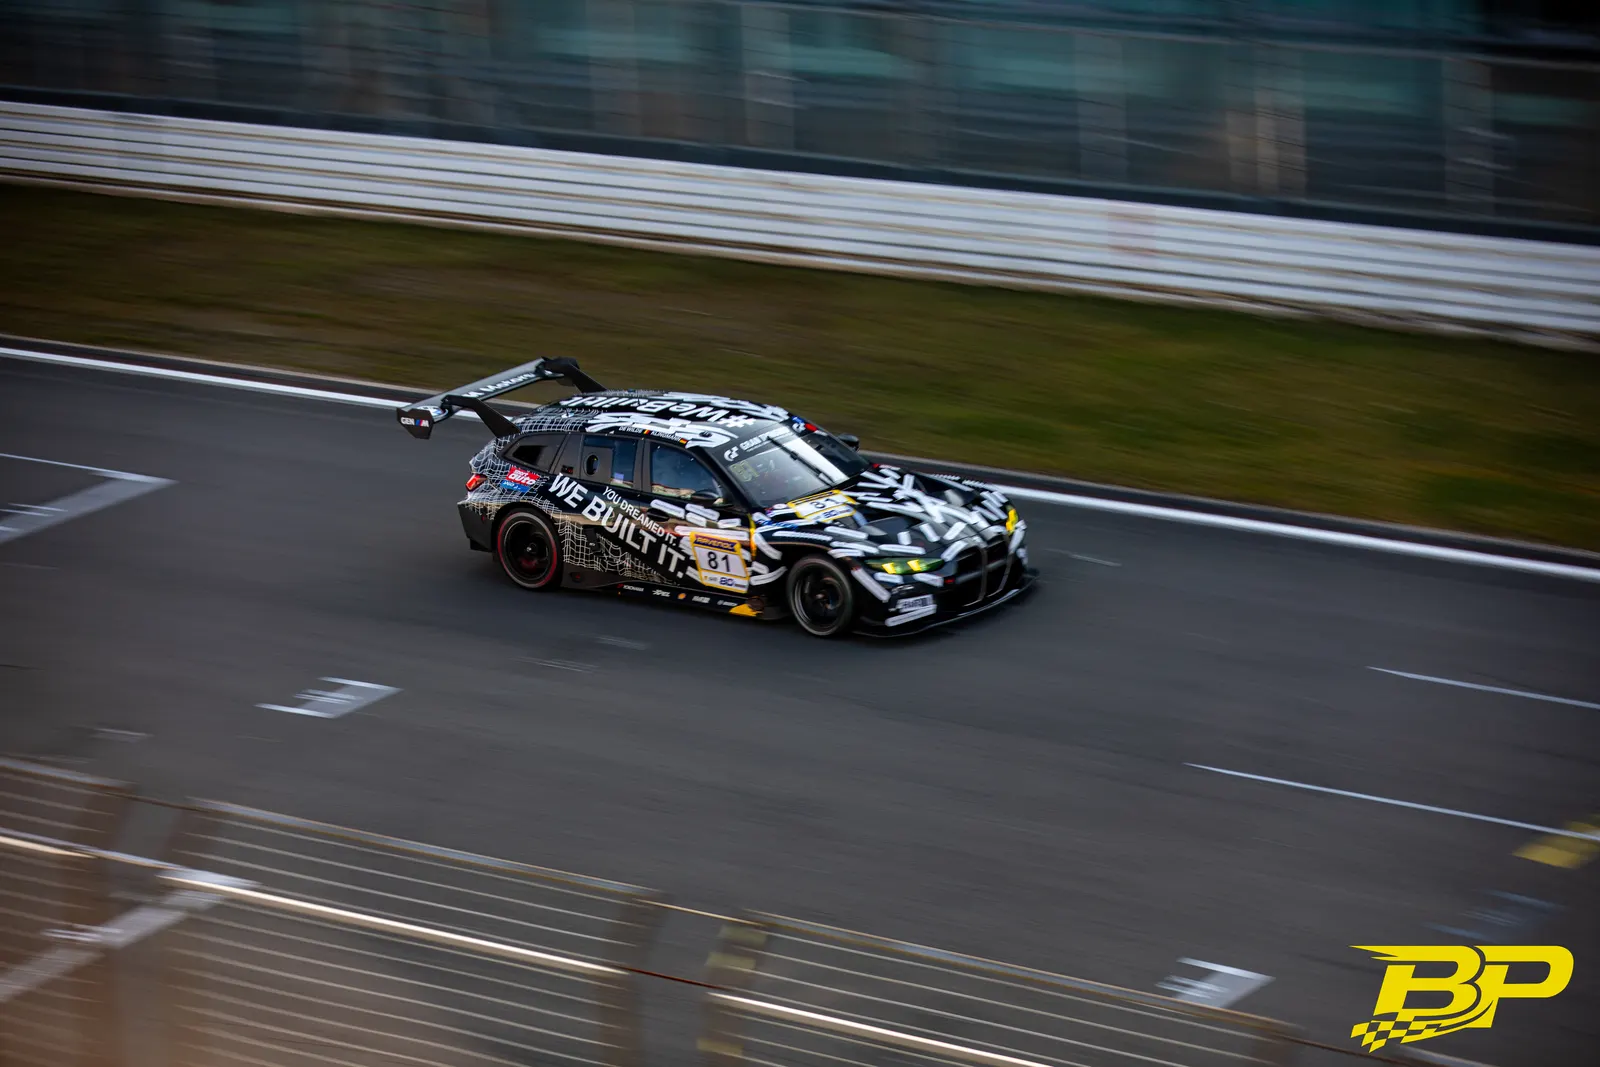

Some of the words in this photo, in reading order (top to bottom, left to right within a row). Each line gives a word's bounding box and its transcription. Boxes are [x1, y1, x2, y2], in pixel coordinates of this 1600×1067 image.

[400, 416, 415, 426] GEN
[508, 473, 536, 485] auto
[548, 473, 588, 509] WE
[582, 496, 657, 555] BUILT
[657, 543, 686, 579] IT.
[603, 486, 621, 504] YOU
[621, 500, 665, 538] DREAMED
[664, 533, 677, 546] IT.
[707, 551, 731, 572] 81
